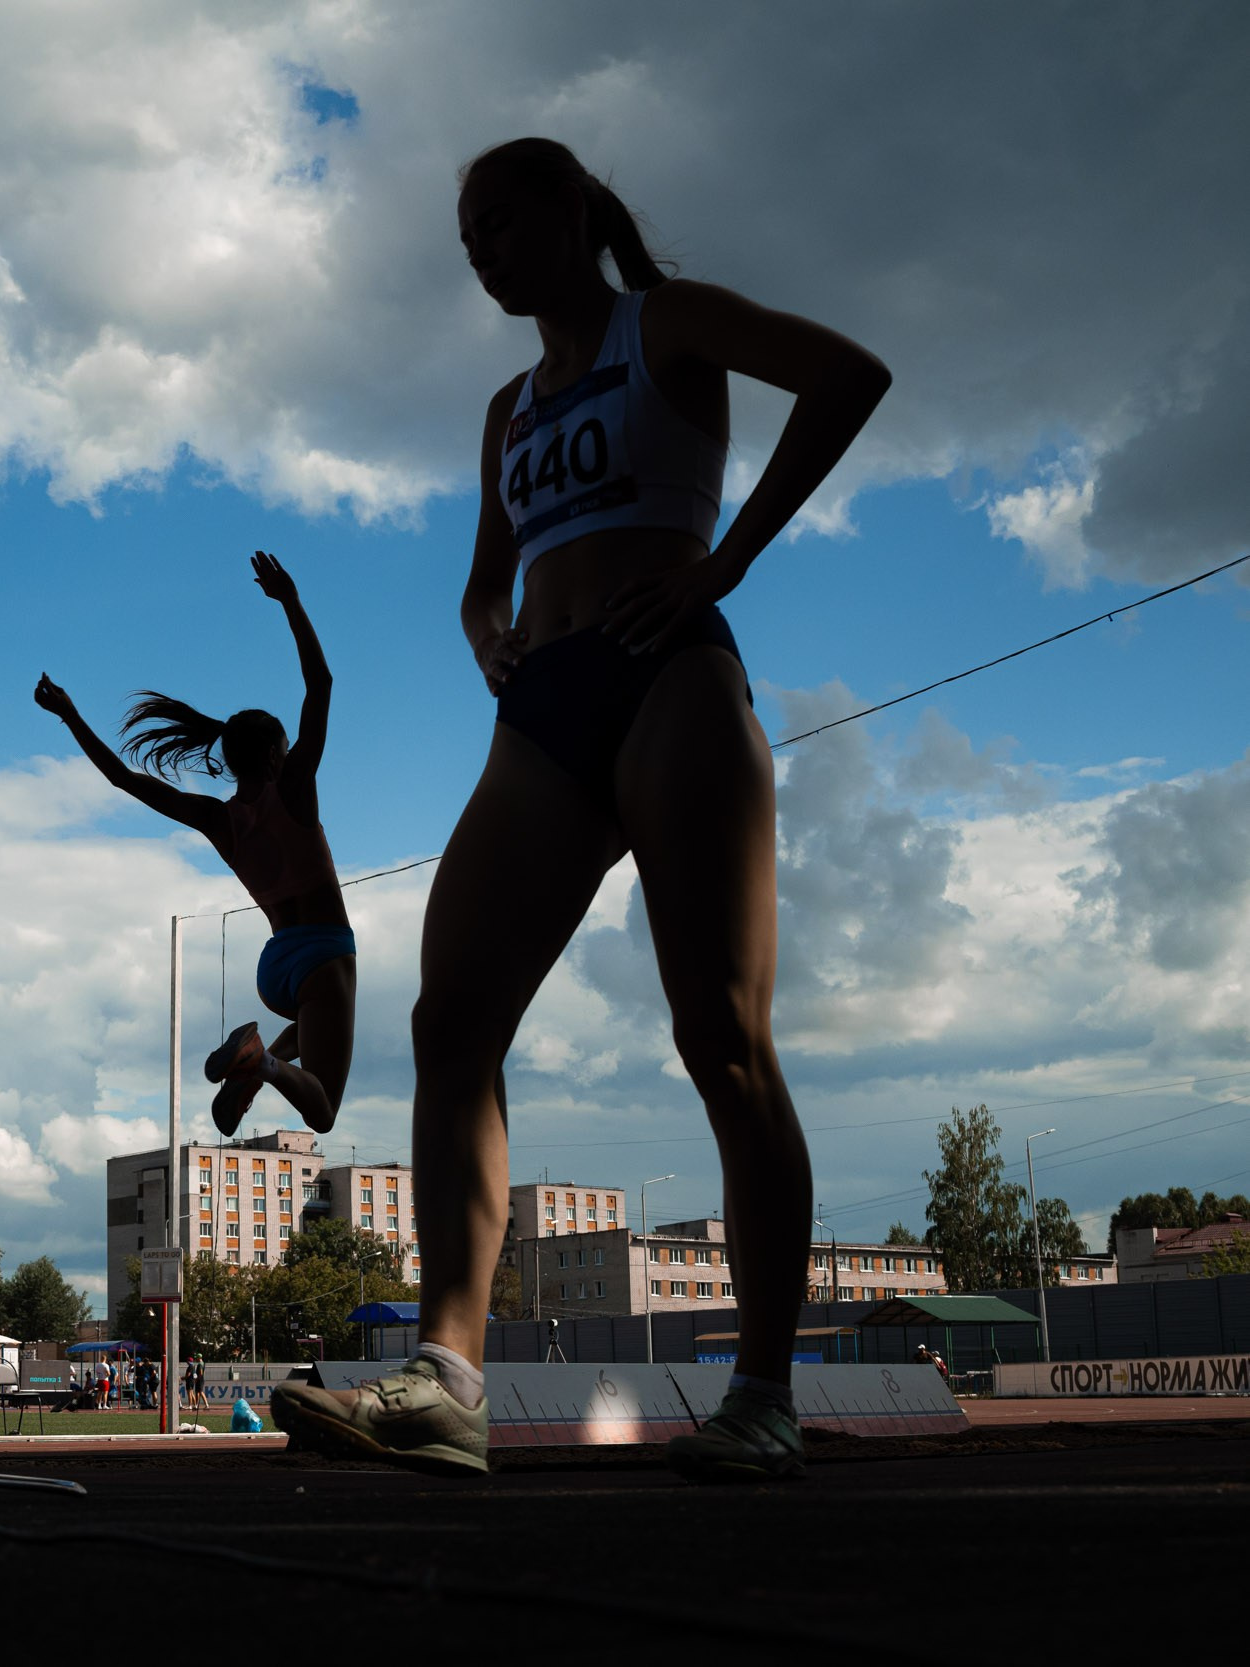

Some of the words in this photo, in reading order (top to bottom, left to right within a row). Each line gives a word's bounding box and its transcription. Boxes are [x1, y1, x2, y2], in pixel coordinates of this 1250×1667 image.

[508, 418, 608, 508] 440
[143, 1251, 159, 1259] LAPS
[598, 1368, 618, 1397] 6
[880, 1368, 901, 1394] 8
[1050, 1363, 1113, 1393] СПОРТ
[1129, 1360, 1206, 1391] НОРМА
[1208, 1358, 1250, 1391] ЖИ
